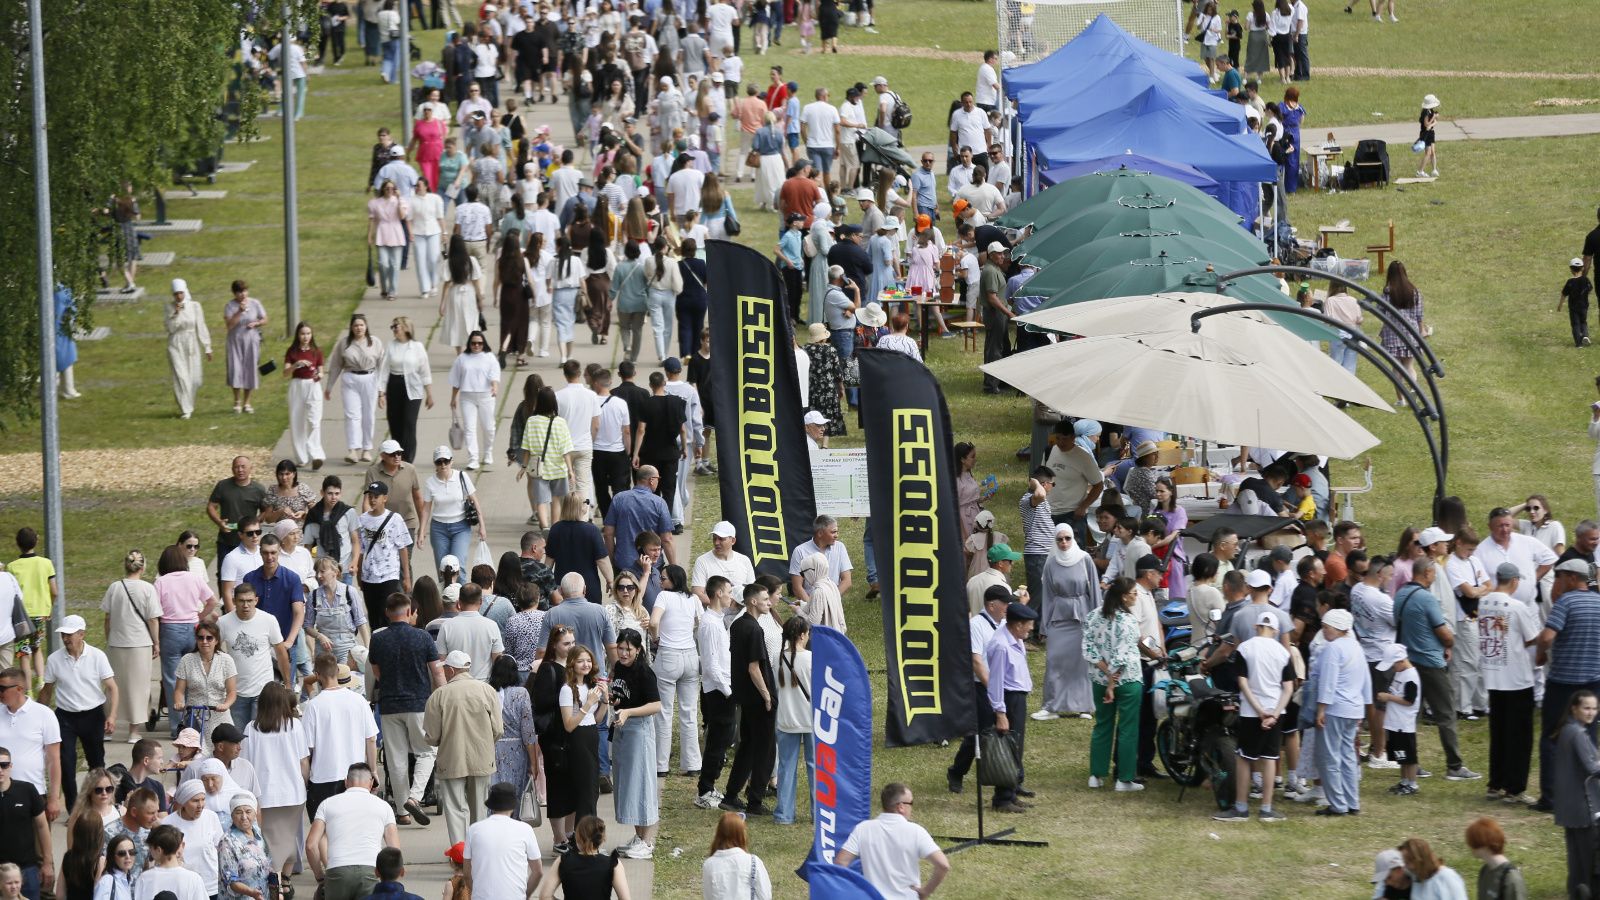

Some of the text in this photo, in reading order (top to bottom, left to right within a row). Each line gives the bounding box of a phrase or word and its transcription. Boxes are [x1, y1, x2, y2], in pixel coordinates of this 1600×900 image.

[740, 298, 787, 561] MOTO BOSS
[896, 412, 938, 711] MOTO BOSS
